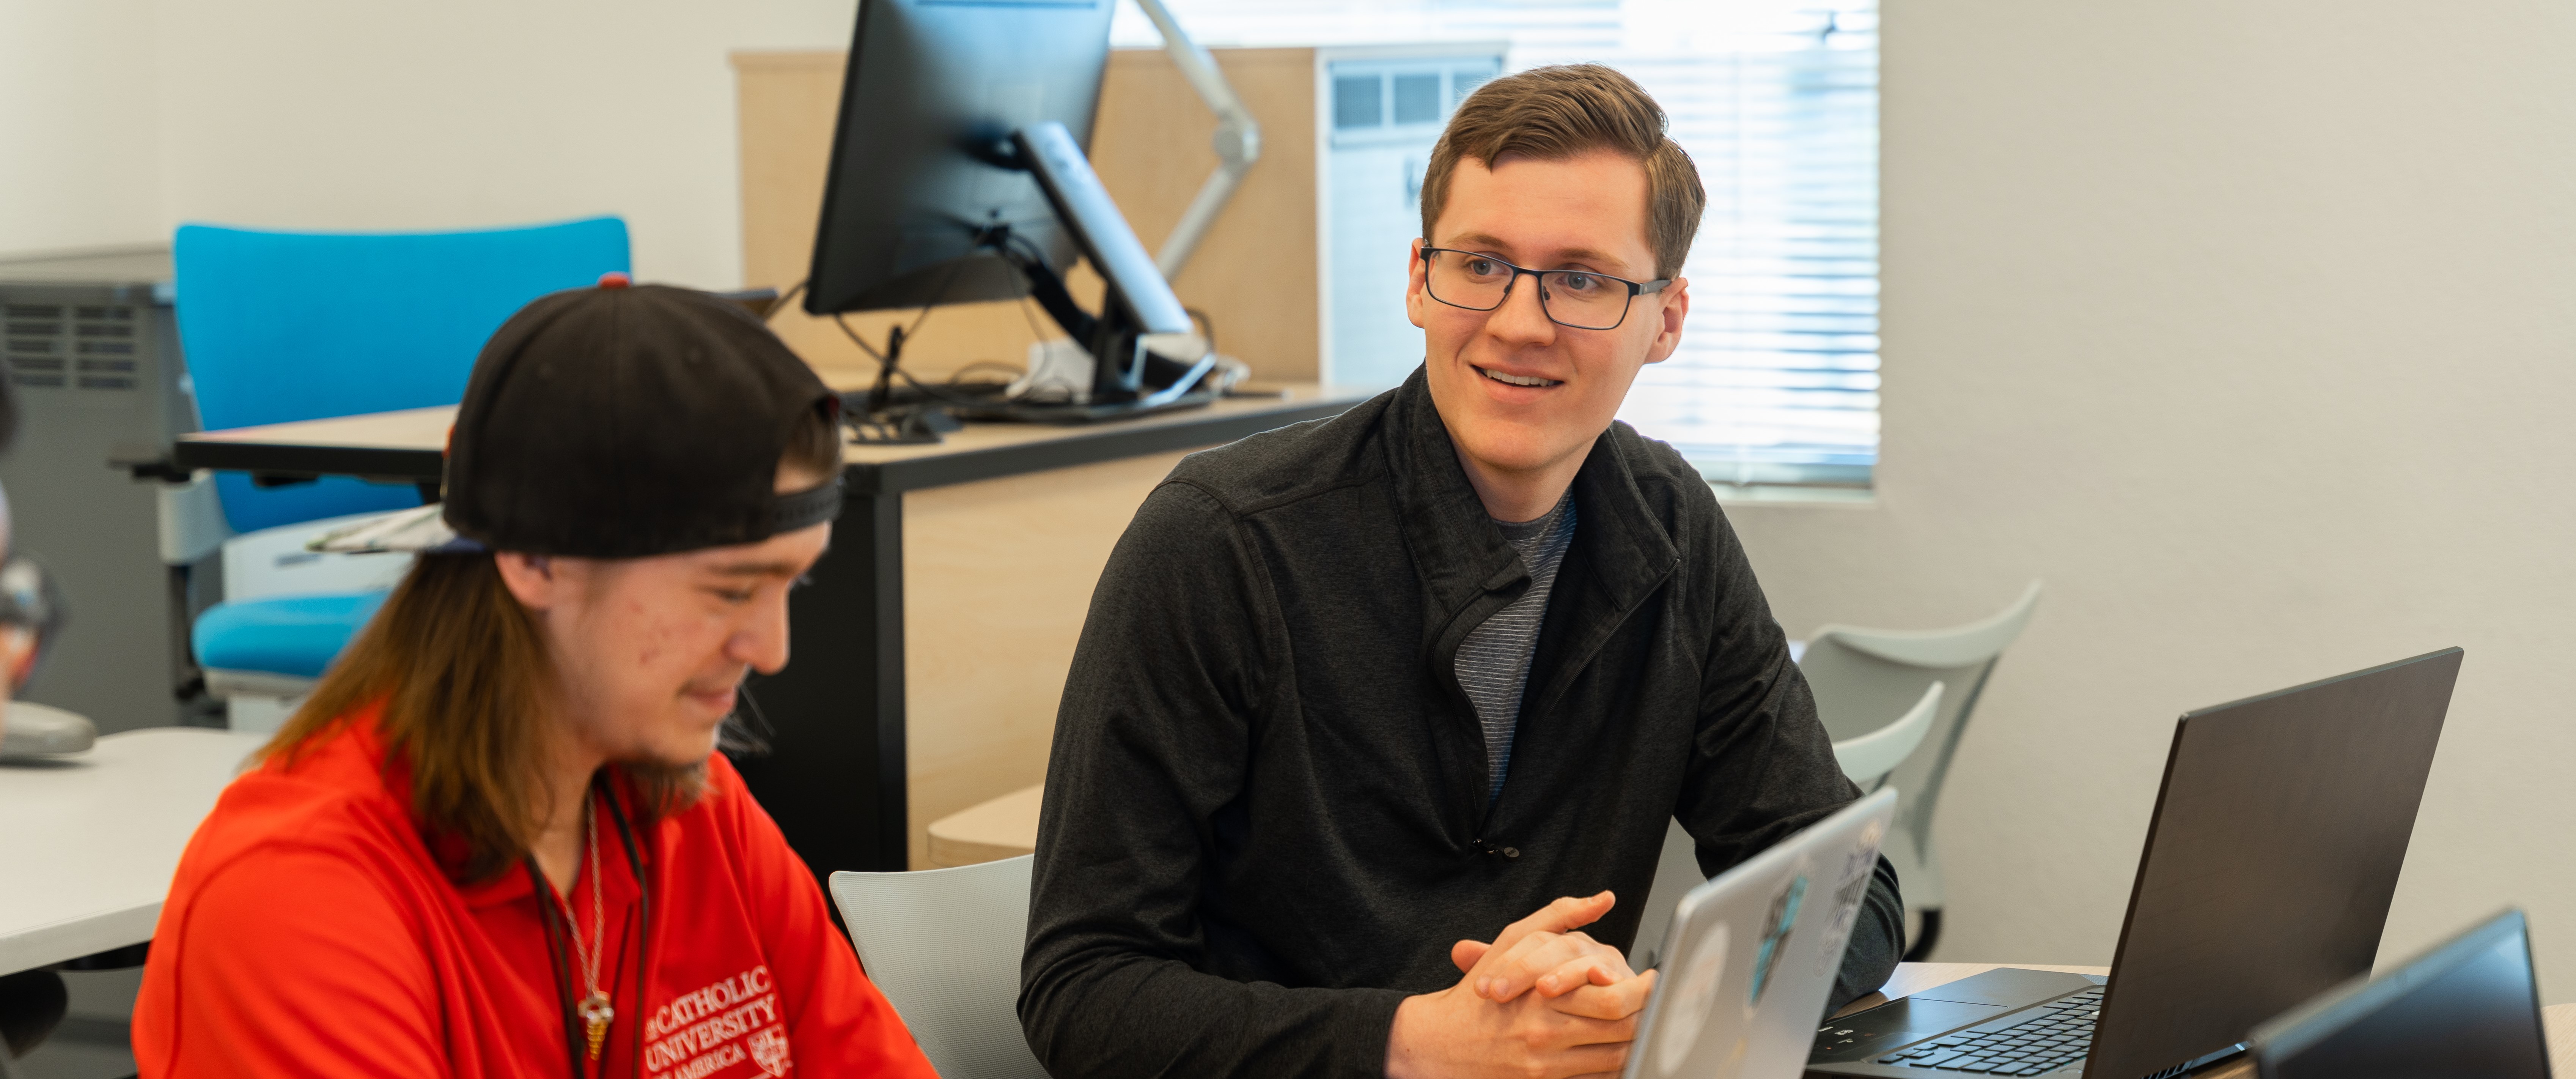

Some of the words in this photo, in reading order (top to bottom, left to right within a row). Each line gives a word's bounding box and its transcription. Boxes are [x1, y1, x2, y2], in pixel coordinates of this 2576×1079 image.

[645, 993, 776, 1072] UNIVERSITY
[656, 965, 771, 1034] CATHOLIC
[674, 1041, 747, 1079] AMERICA
